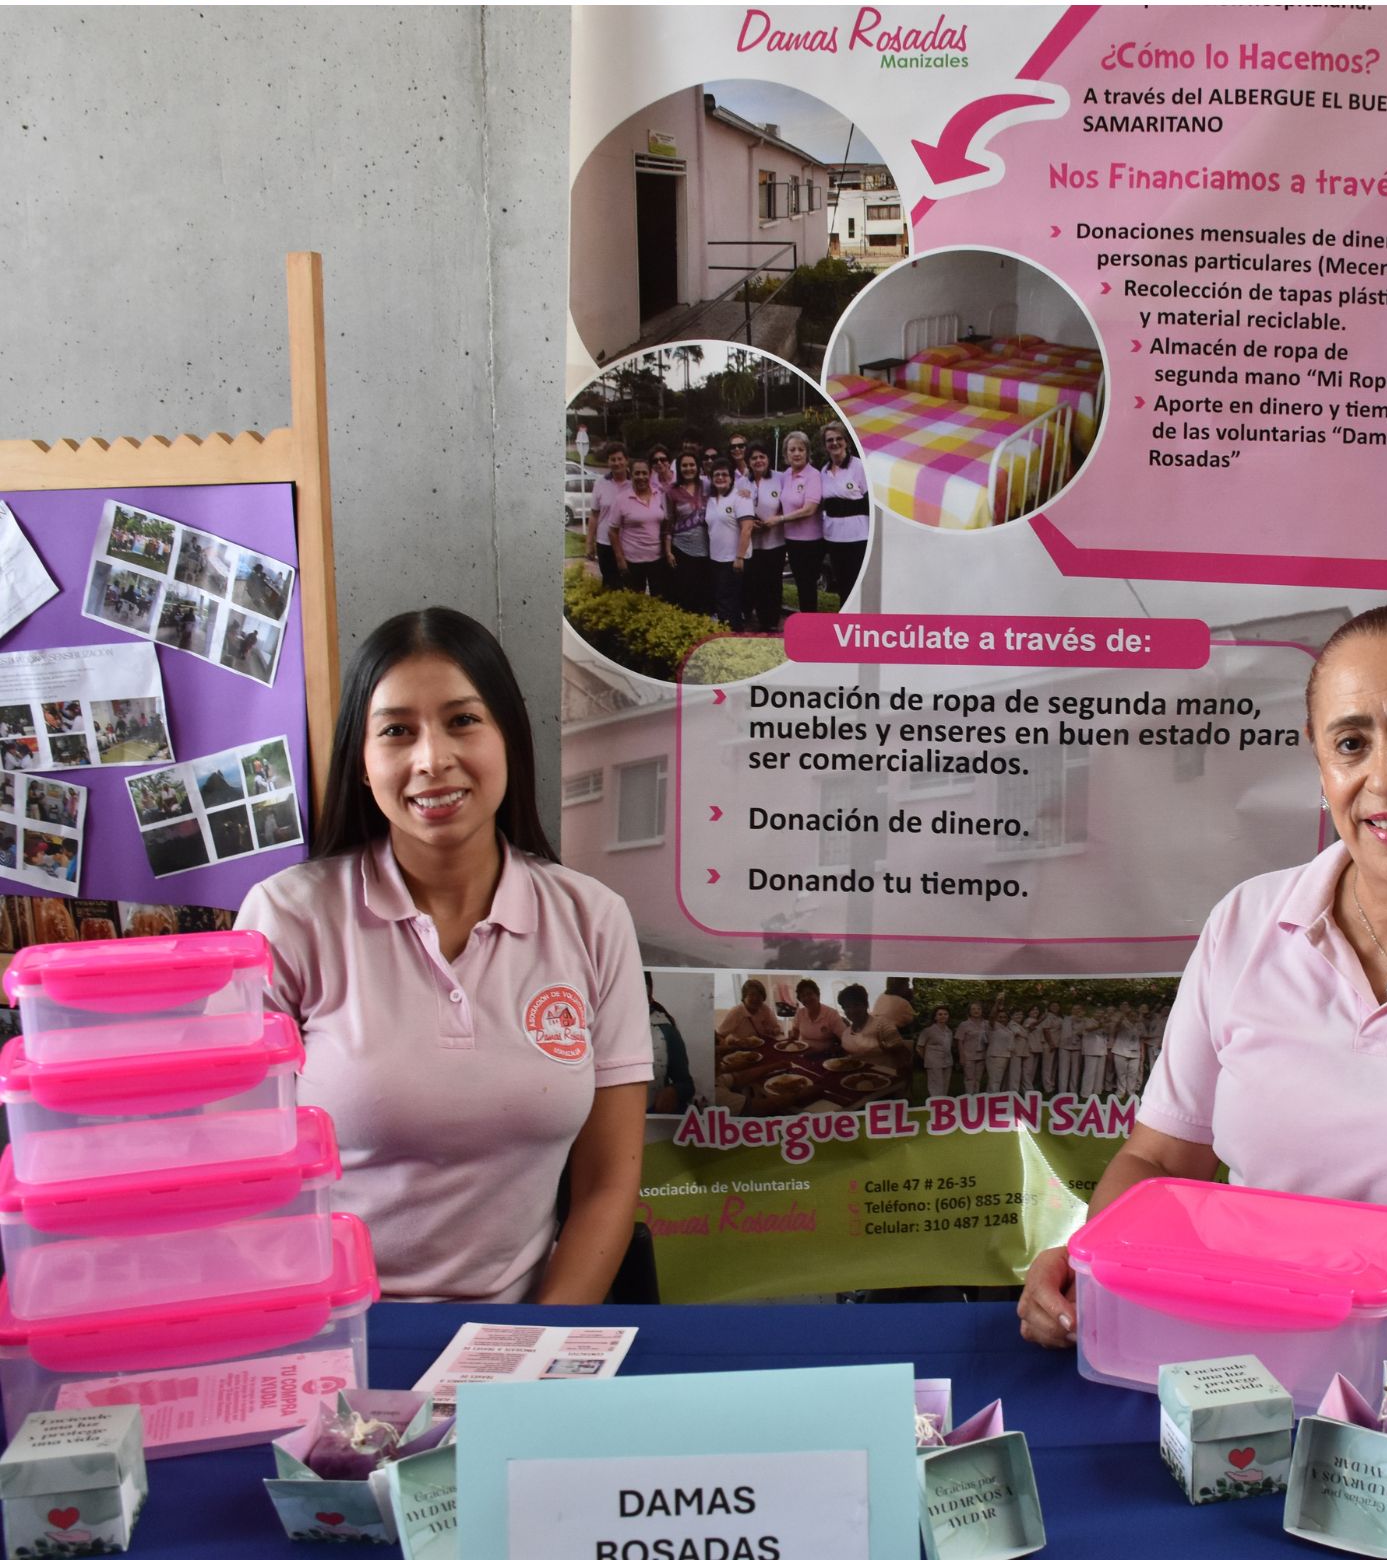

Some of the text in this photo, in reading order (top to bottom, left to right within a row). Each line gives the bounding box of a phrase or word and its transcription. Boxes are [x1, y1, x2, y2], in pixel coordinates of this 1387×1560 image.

[736, 7, 968, 53] Damas Rosadas
[880, 53, 968, 69] Manizales
[1101, 42, 1381, 74] ¿Cómo lo Hacemos?
[1083, 89, 1098, 105] A
[1104, 87, 1165, 106] través
[1172, 88, 1202, 106] del
[1208, 89, 1316, 108] ALBERGUE
[1322, 92, 1342, 109] EL
[1083, 115, 1223, 134] SAMARITANO
[1049, 163, 1099, 189] Nos
[1109, 163, 1280, 193] Financiamos
[1290, 173, 1305, 194] a
[1076, 223, 1194, 242] Donaciones
[1200, 226, 1306, 246] mensuales
[1312, 230, 1336, 247] de
[1097, 252, 1188, 271] personas
[1194, 253, 1312, 274] particulares
[833, 623, 1152, 654] Vincúlate a través de:
[749, 806, 1030, 838] Donación de dinero.
[749, 867, 1028, 902] Donando tu tiempo.
[677, 1105, 856, 1161] Albergue
[869, 1102, 916, 1135] EL
[930, 1094, 1040, 1132] BUEN
[732, 1179, 810, 1193] Voluntarias
[864, 1176, 976, 1194] Calle 47 # 26-35
[864, 1212, 1018, 1237] Celular: 310 487 1248
[1185, 1363, 1248, 1376] Enciende
[936, 1475, 996, 1497] Gracias por
[618, 1486, 756, 1518] DAMAS
[949, 1507, 997, 1528] AYUDAR
[596, 1535, 781, 1560] ROSADAS
